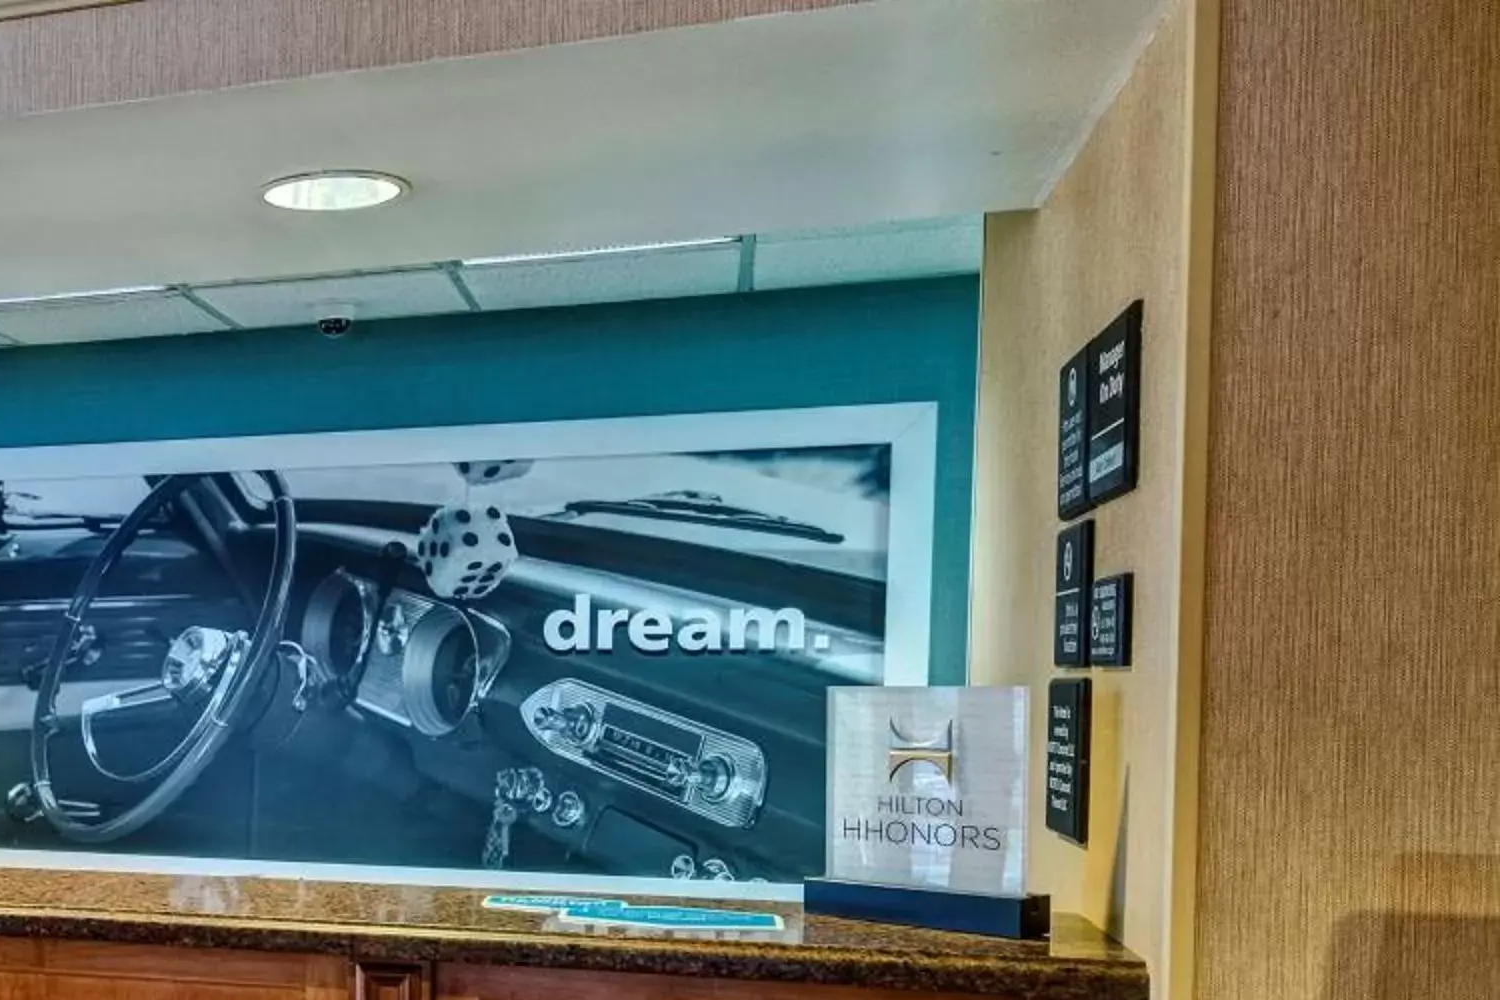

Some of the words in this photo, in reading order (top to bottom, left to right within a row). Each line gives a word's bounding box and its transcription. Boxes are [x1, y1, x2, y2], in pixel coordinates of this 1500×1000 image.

[542, 593, 831, 652] dream.
[877, 796, 964, 818] HILTON
[842, 816, 1002, 852] HHONORS
